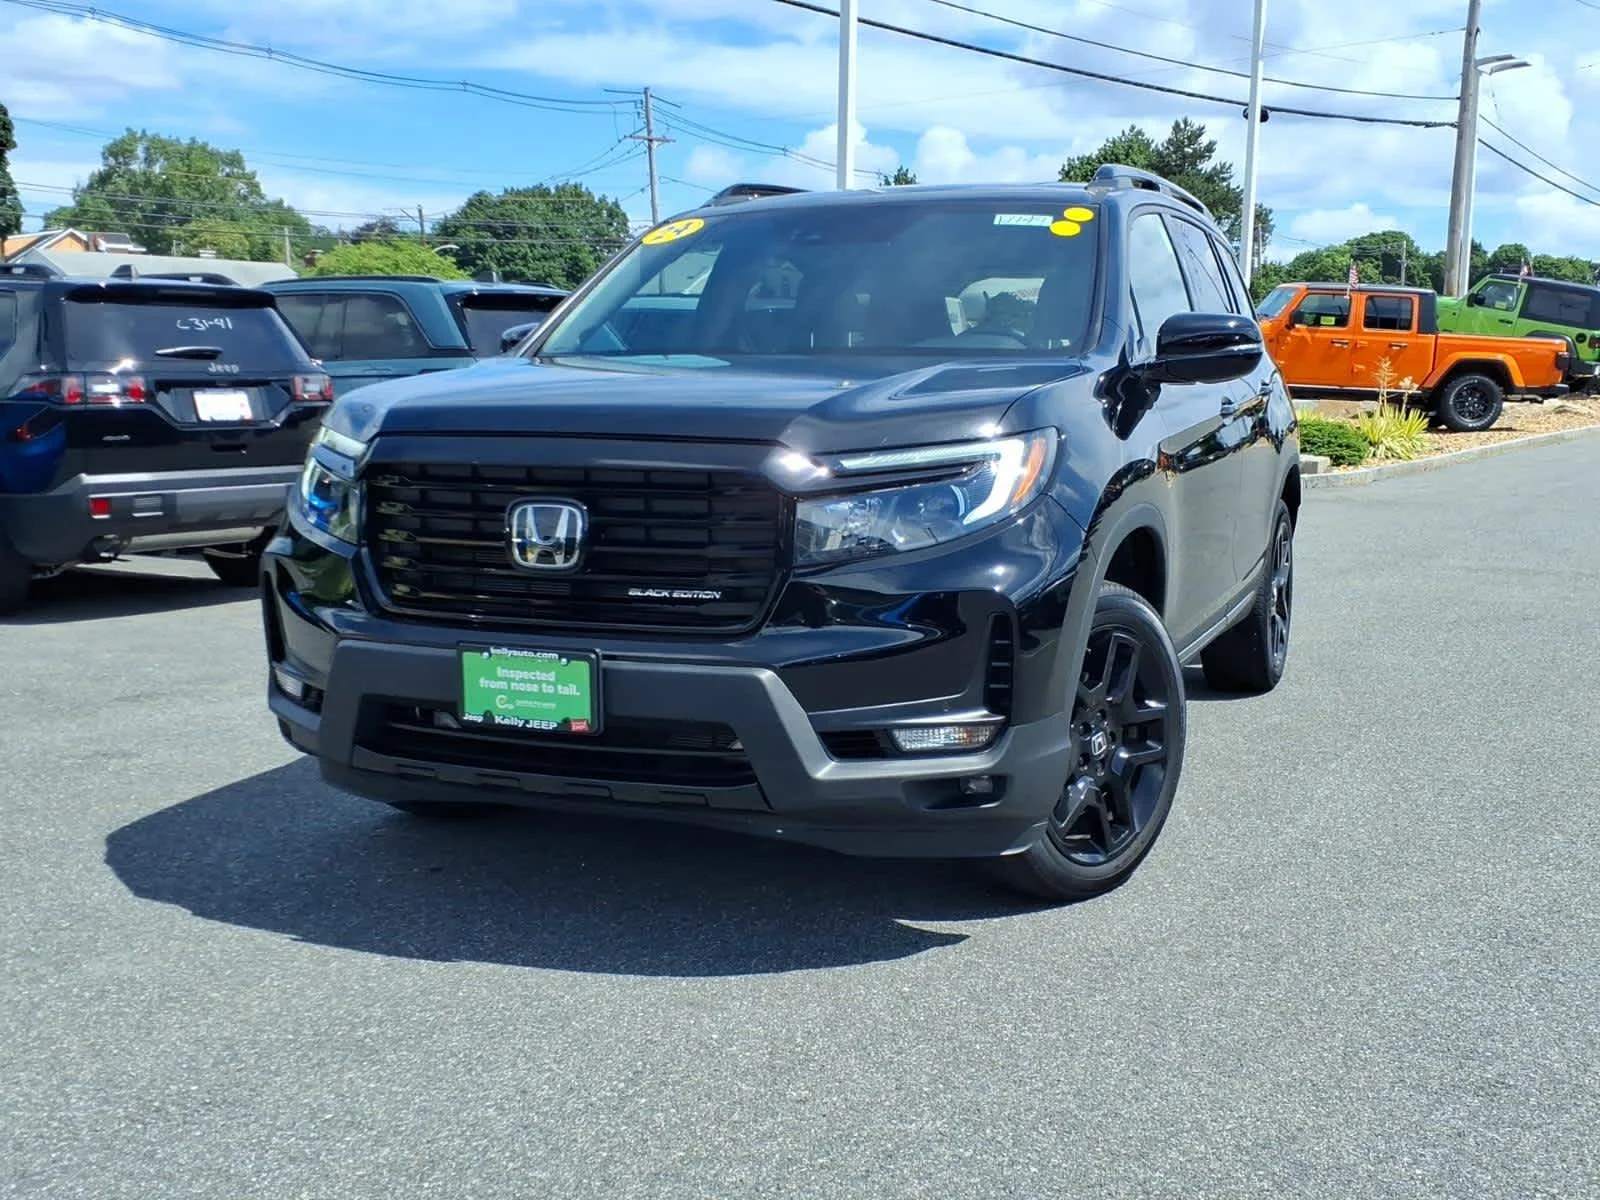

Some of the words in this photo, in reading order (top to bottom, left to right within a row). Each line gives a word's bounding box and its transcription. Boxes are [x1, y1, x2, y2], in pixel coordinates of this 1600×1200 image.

[628, 588, 671, 598] BLACK
[672, 589, 722, 599] EDITION
[490, 647, 559, 660] kellyauto.com
[496, 666, 556, 682] Inspected
[479, 677, 509, 689] from
[510, 682, 539, 693] nose
[541, 683, 555, 693] to
[557, 684, 580, 696] tail.
[495, 715, 525, 728] Kelly
[526, 719, 558, 730] JEEP
